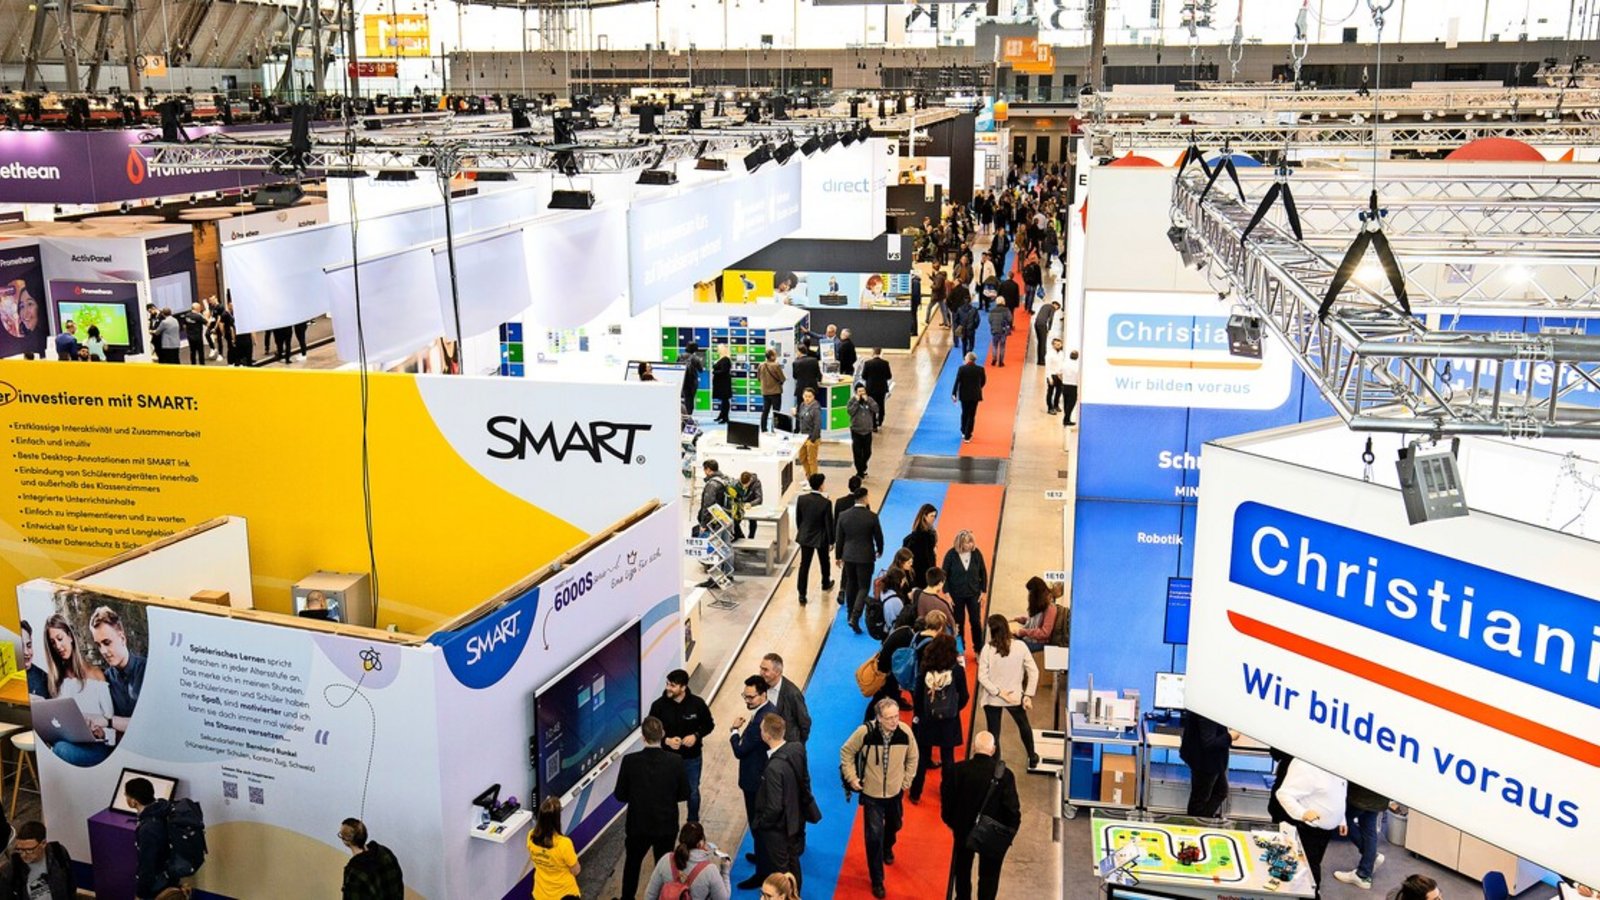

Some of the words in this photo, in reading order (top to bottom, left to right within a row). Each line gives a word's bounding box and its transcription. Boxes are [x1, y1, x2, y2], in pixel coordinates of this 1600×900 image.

[0, 162, 60, 180] ethean
[822, 178, 869, 192] direct
[71, 254, 112, 264] ActivPanel
[1116, 320, 1228, 344] Christia
[1115, 376, 1142, 390] Wir
[1146, 378, 1193, 392] bilden
[1197, 380, 1250, 394] voraus
[18, 389, 103, 406] investieren
[108, 394, 133, 408] mit
[137, 394, 198, 411] SMART:
[14, 422, 60, 433] Erstklassige
[62, 424, 112, 434] Interaktivität
[114, 427, 130, 435] und
[132, 427, 201, 438] Zusammenarbeit
[16, 437, 45, 446] Einfach
[47, 438, 62, 447] und
[64, 439, 91, 448] intuitiv
[486, 416, 652, 465] SMART
[18, 452, 40, 460] Beste
[41, 452, 130, 465] Desktop-Annotationen
[132, 457, 145, 465] mit
[147, 458, 175, 467] SMART
[20, 467, 64, 478] Einbindung
[82, 469, 158, 481] Schülerendgeräten
[160, 473, 199, 483] innerhalb
[21, 479, 36, 487] und
[38, 479, 79, 489] außerhalb
[80, 481, 95, 489] des
[96, 482, 161, 493] Klassenzimmers
[22, 493, 64, 503] Integrierte
[66, 495, 136, 506] Unterrichtsinhalte
[25, 508, 53, 517] Einfach
[66, 509, 128, 520] implementieren
[129, 513, 144, 521] und
[158, 516, 186, 524] warten
[26, 522, 65, 531] Entwickelt
[67, 524, 78, 532] für
[80, 525, 113, 536] Leistung
[115, 527, 130, 535] und
[28, 536, 62, 545] Höchster
[64, 538, 112, 548] Datenschutz
[1137, 532, 1183, 545] Robotik
[554, 571, 593, 612] 6000S
[1251, 526, 1600, 684] Christiani
[466, 610, 521, 666] SMART
[190, 644, 238, 660] Spielerisches
[239, 653, 266, 664] Lernen
[267, 656, 292, 668] spricht
[183, 655, 219, 668] Menschen
[229, 664, 248, 673] jeder
[250, 667, 288, 680] Altersstufe
[183, 667, 196, 677] Das
[198, 670, 220, 680] merke
[222, 674, 233, 683] ich
[243, 678, 270, 690] meinen
[180, 678, 192, 688] Die
[194, 680, 239, 695] Schülerinnen
[240, 690, 255, 699] und
[256, 692, 283, 704] Schüler
[285, 697, 309, 709] haben
[181, 692, 199, 700] mehr
[224, 699, 238, 708] sind
[240, 702, 281, 716] motivierter
[283, 710, 298, 719] und
[300, 712, 311, 721] ich
[188, 704, 206, 714] kann
[207, 708, 217, 716] sie
[218, 709, 236, 720] doch
[238, 713, 261, 724] immer
[263, 717, 278, 728] mal
[279, 720, 305, 732] wieder
[204, 719, 214, 728] ins
[216, 721, 246, 734] Staunen
[1242, 663, 1299, 711] Wir
[1309, 691, 1419, 764] bilden
[1433, 746, 1580, 829] voraus
[252, 754, 273, 765] Kanton
